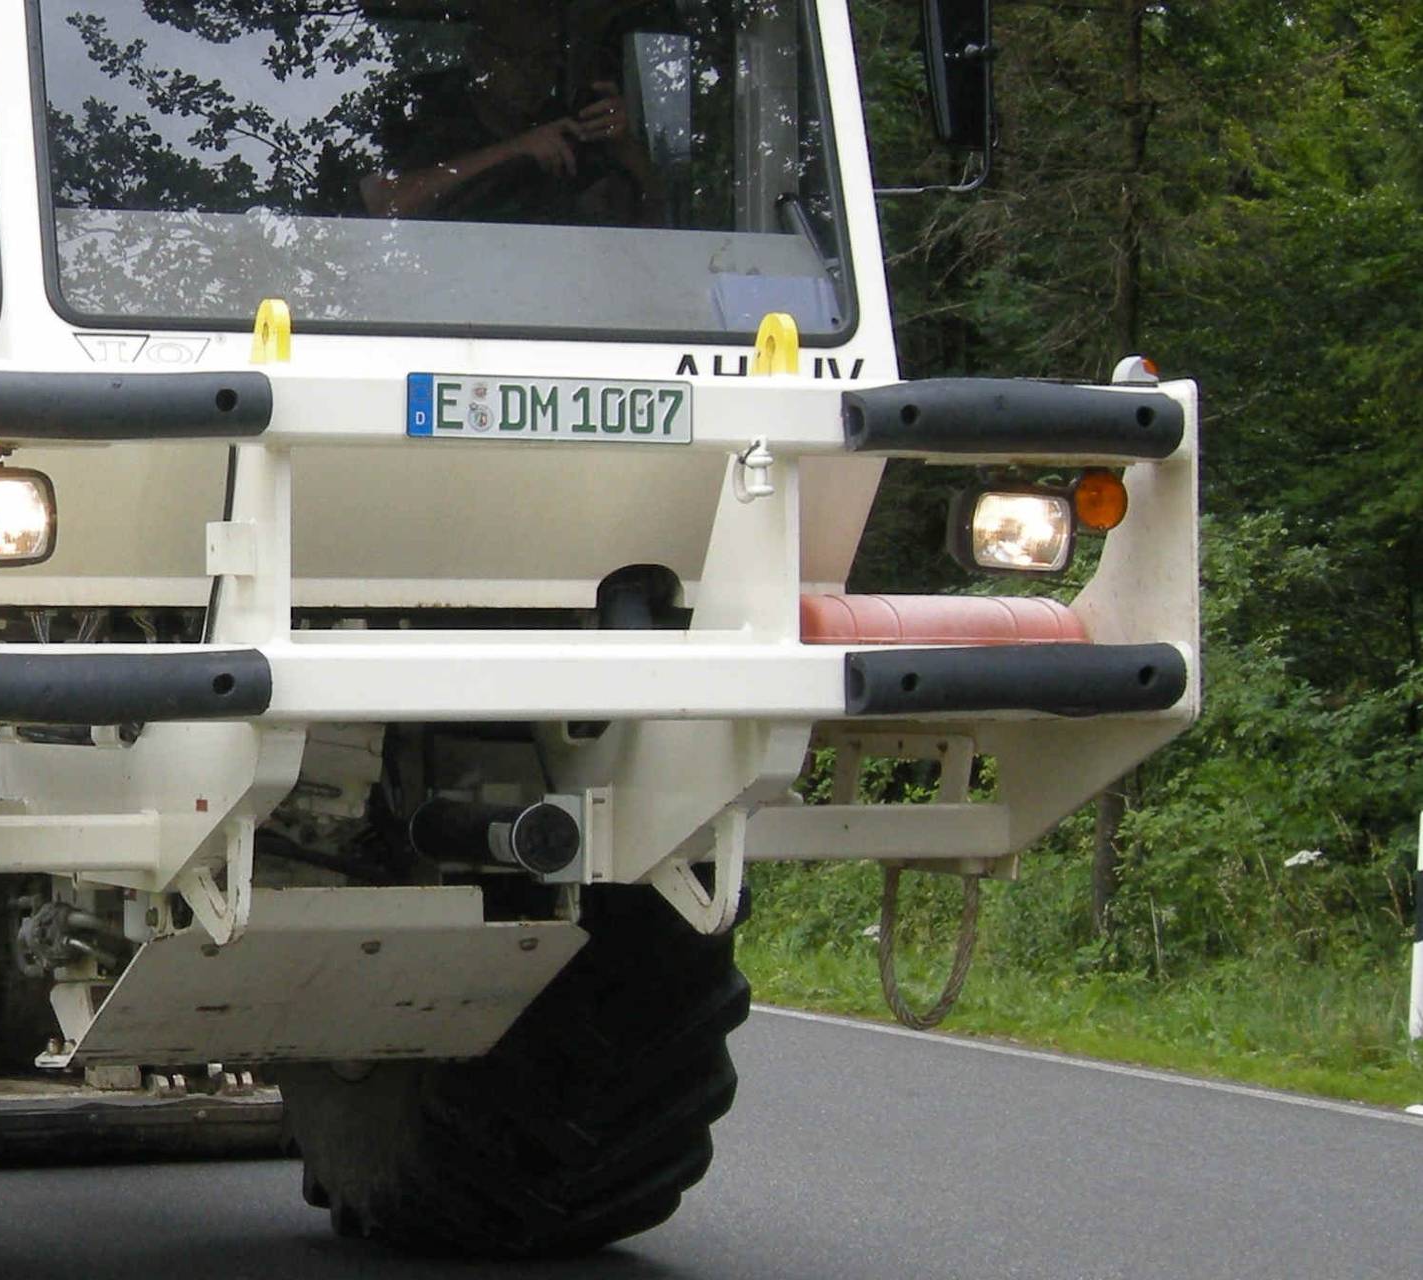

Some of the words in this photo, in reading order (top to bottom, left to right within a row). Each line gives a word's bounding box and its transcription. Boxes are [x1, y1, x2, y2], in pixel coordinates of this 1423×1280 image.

[415, 411, 426, 426] D
[436, 382, 464, 430] E
[498, 384, 559, 432] DM
[571, 385, 684, 435] 1007
